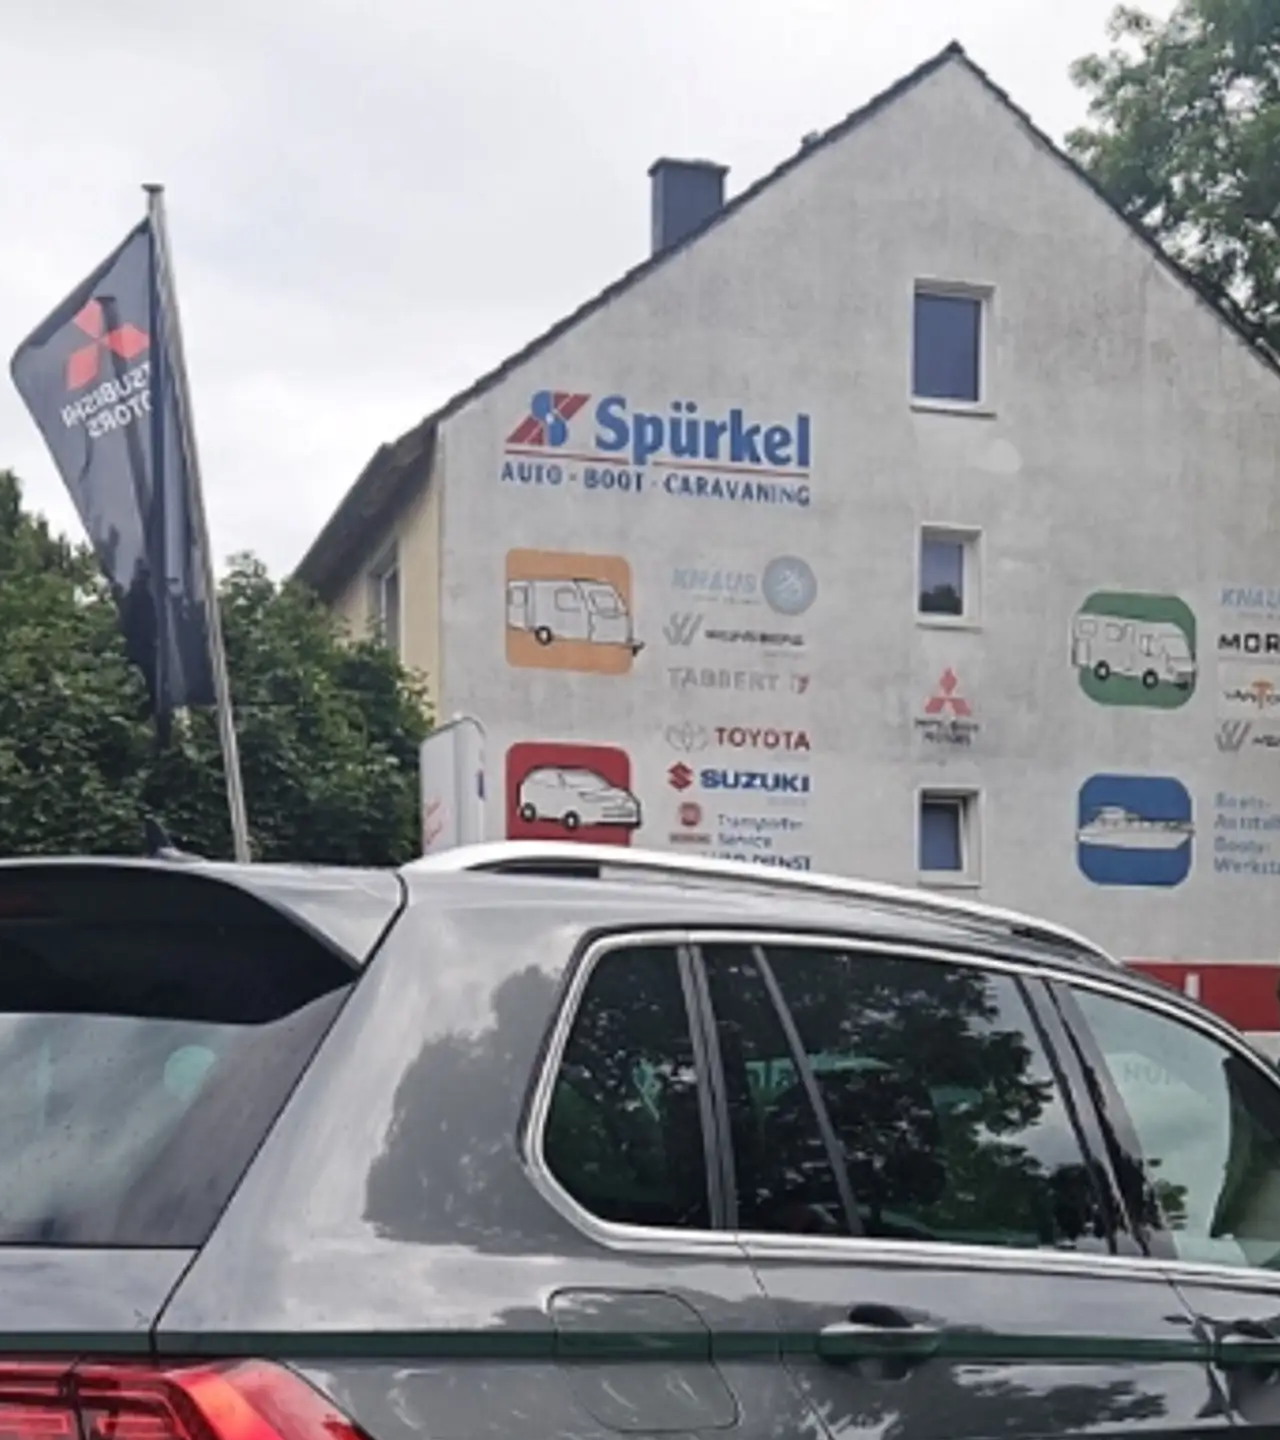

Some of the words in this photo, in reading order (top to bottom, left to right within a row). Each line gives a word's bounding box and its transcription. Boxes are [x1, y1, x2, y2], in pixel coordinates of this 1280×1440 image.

[595, 393, 810, 467] Spürkel
[501, 462, 563, 486] AUTO
[583, 466, 644, 492] BOOT
[663, 472, 811, 507] CARAVANING
[715, 727, 810, 751] TOYOTA
[700, 768, 810, 792] SUZUKI
